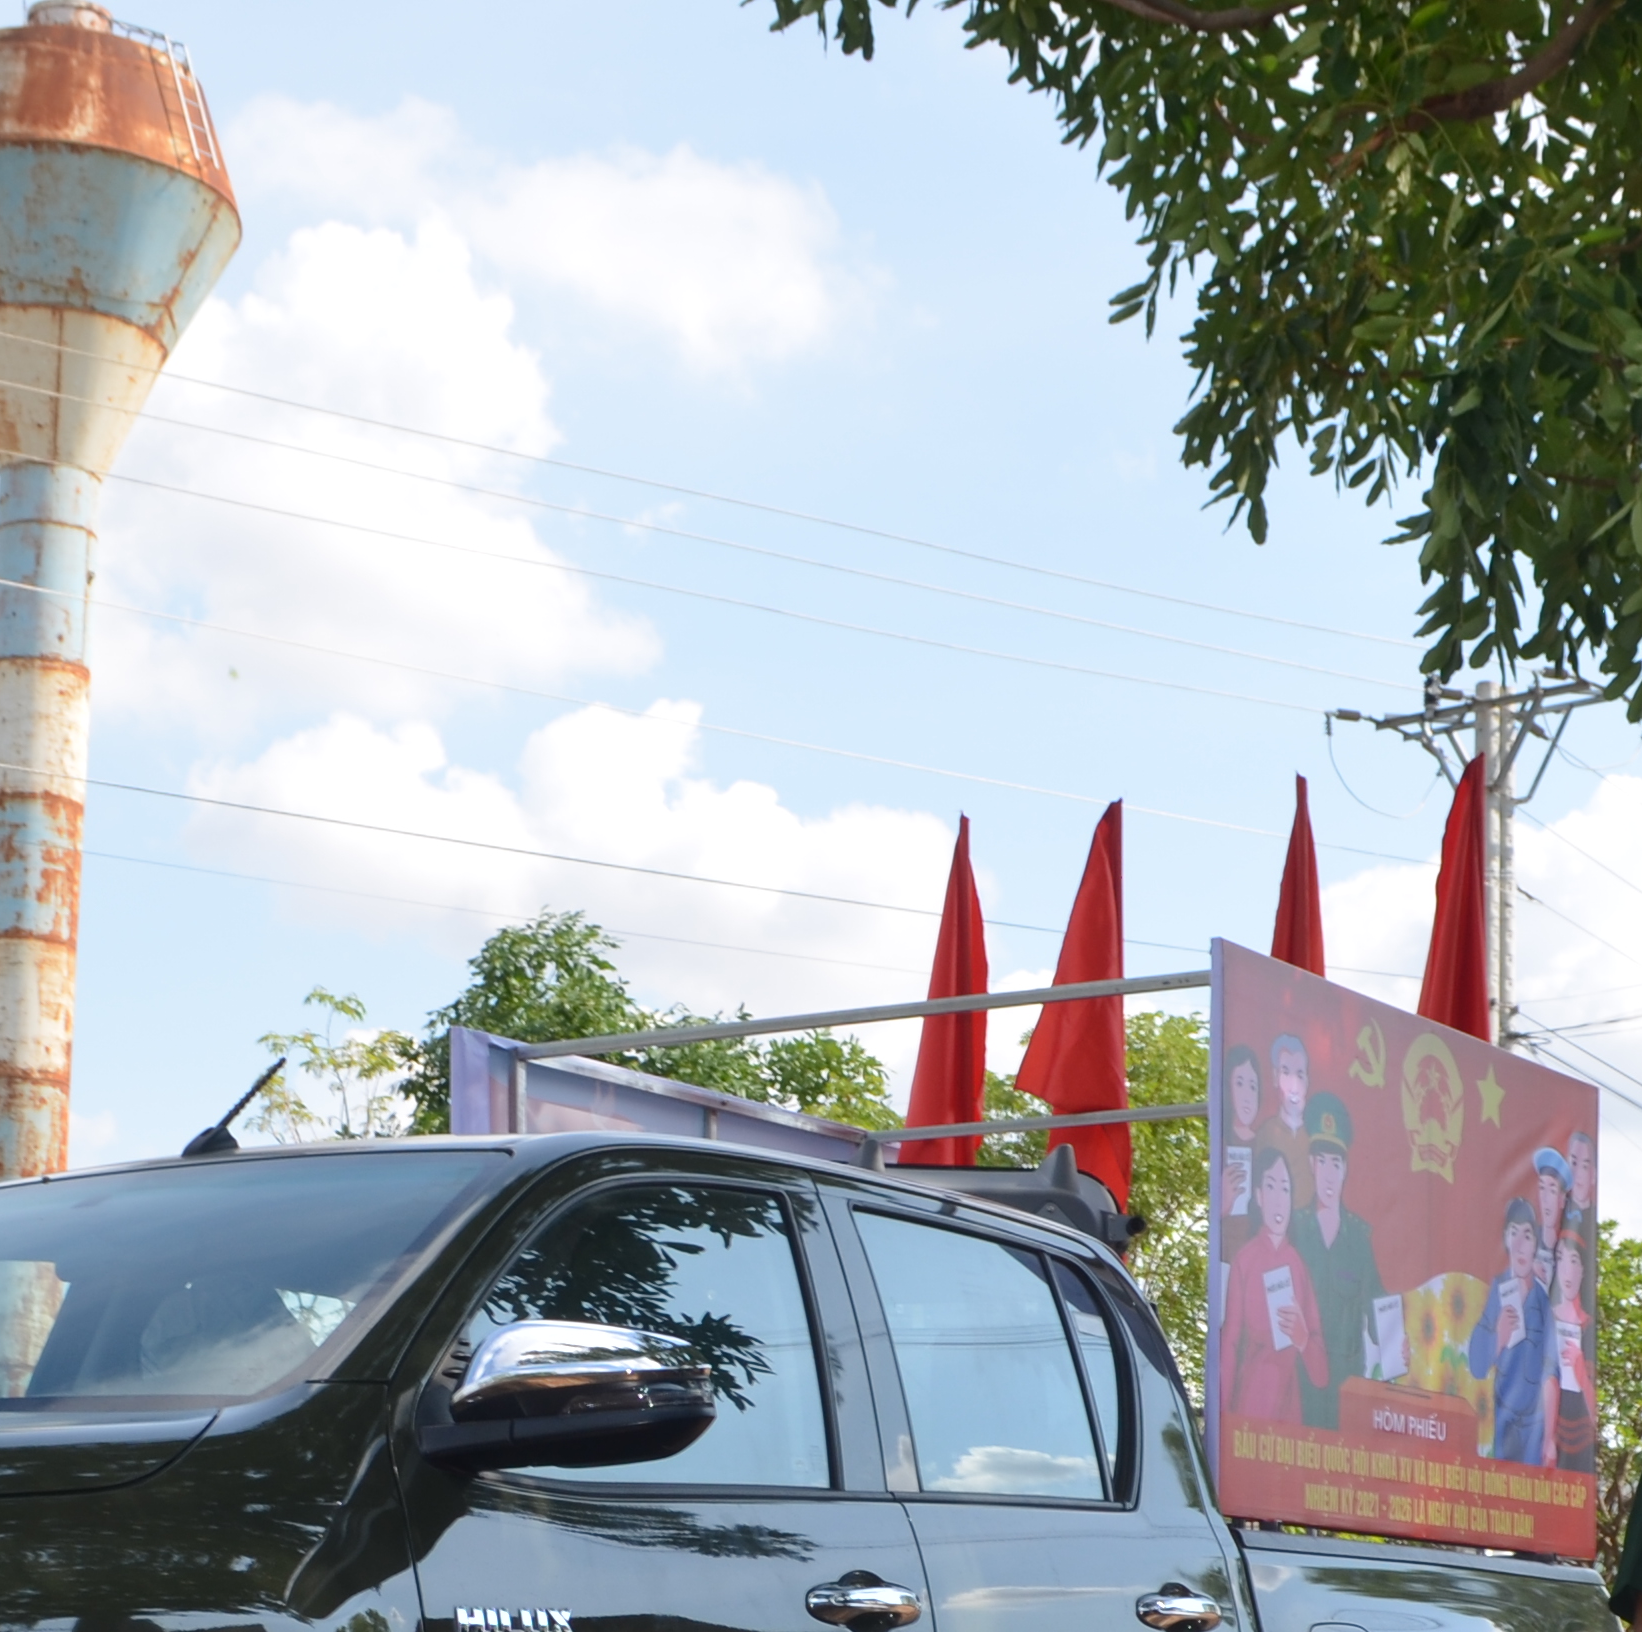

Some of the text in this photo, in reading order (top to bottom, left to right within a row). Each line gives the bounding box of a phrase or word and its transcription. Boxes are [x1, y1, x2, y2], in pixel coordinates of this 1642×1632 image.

[1373, 1406, 1447, 1442] HÒM PHIẾU
[1297, 1430, 1321, 1471] BIỂU
[1322, 1438, 1351, 1474] QUỐC
[1353, 1445, 1370, 1482] HỘI
[1399, 1456, 1413, 1484] XV
[1414, 1455, 1426, 1486] VÀ
[1445, 1455, 1466, 1492] BIỂU
[1467, 1463, 1483, 1500] HỘI
[1357, 1489, 1379, 1518] 2021
[1389, 1494, 1413, 1523] 2026
[1414, 1493, 1426, 1525] LÀ
[1427, 1496, 1452, 1528] NGÀY
[1454, 1499, 1469, 1536] HỘI
